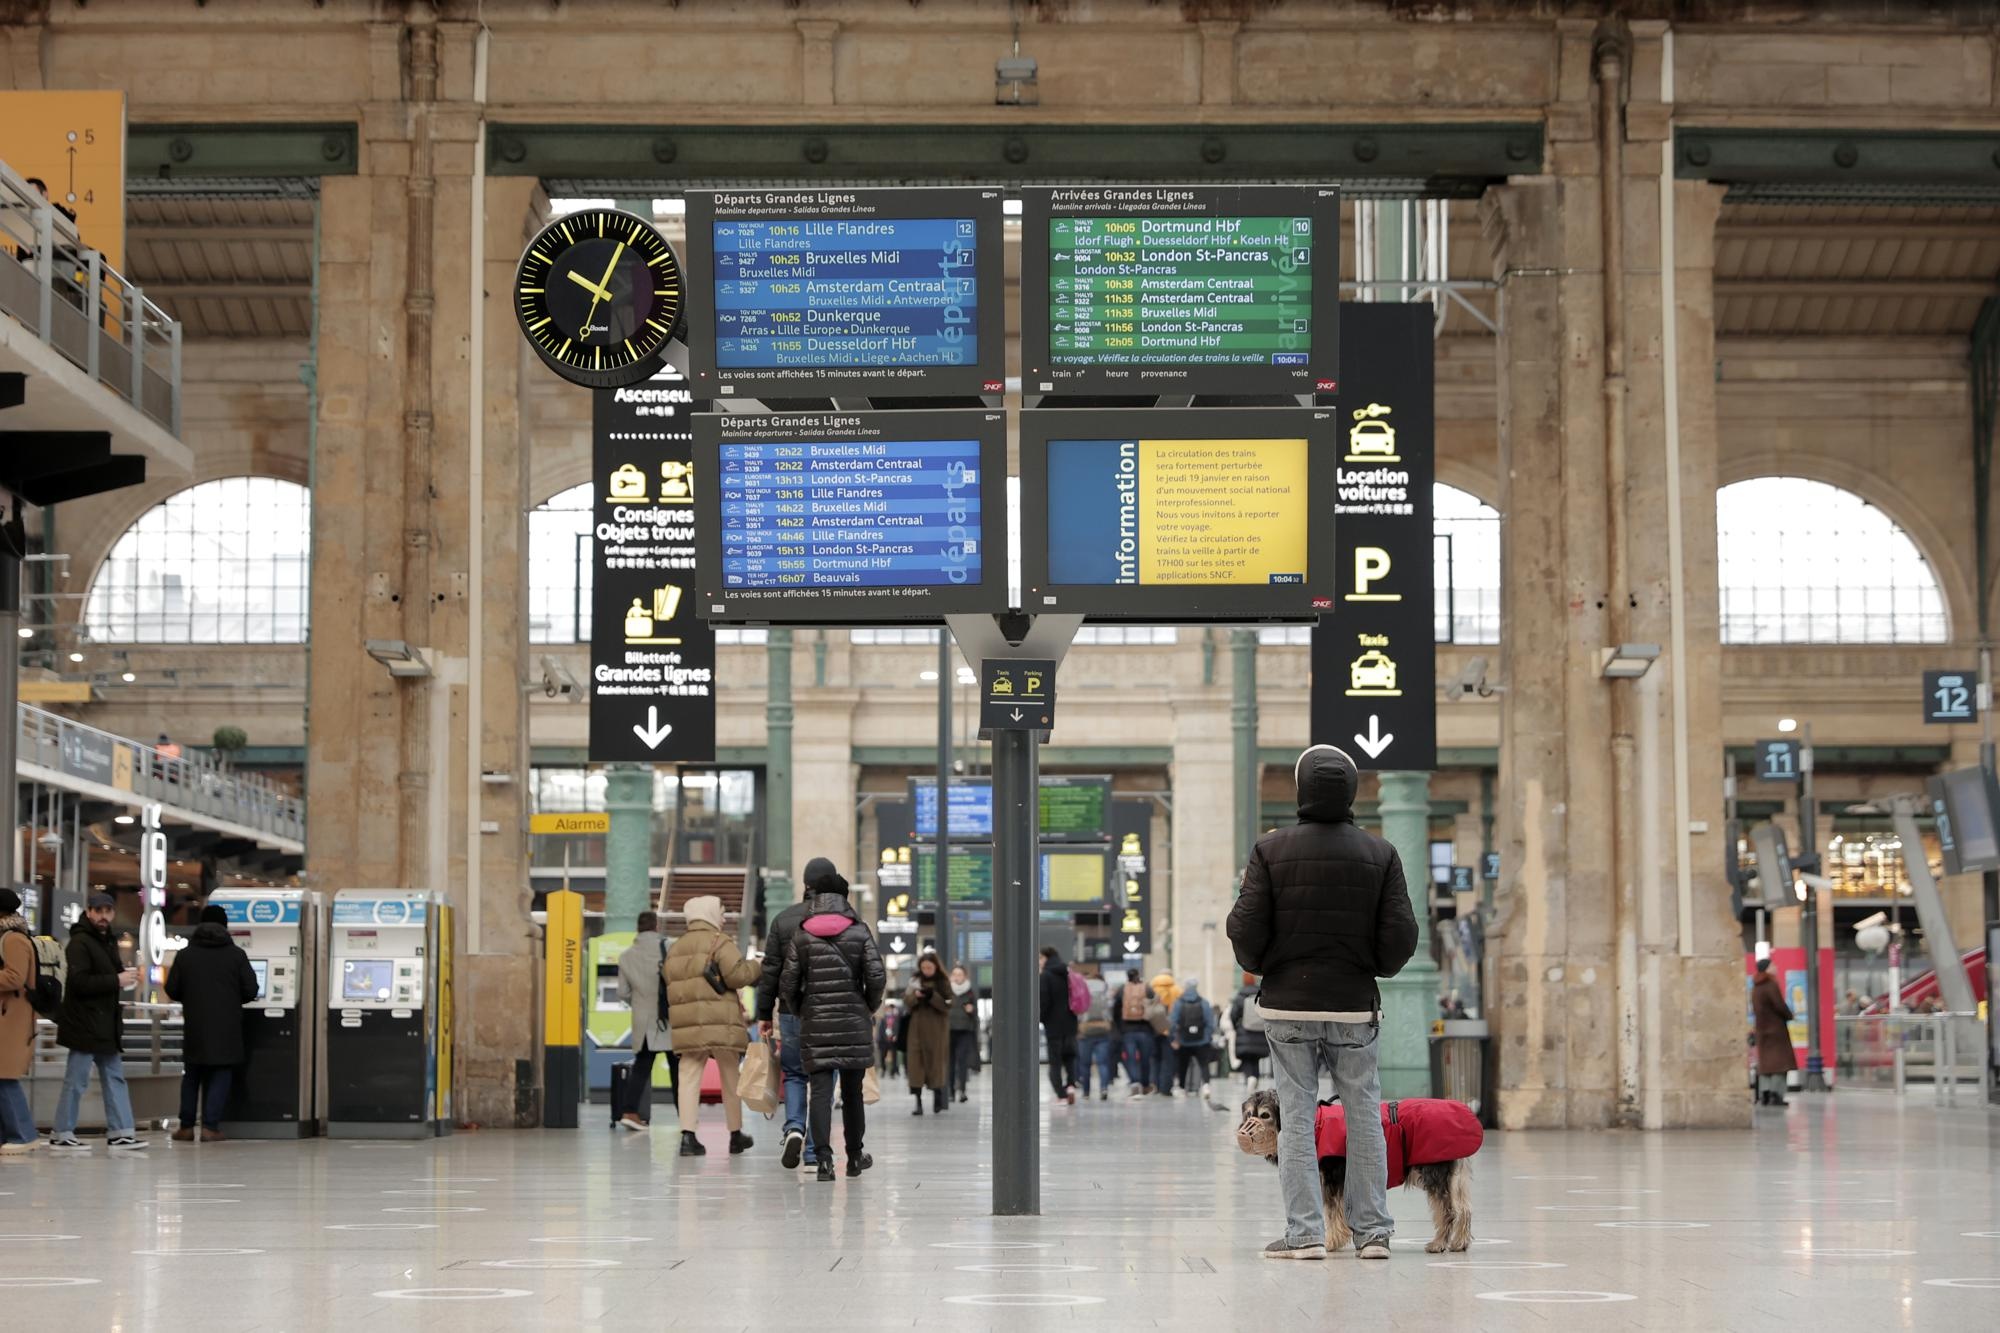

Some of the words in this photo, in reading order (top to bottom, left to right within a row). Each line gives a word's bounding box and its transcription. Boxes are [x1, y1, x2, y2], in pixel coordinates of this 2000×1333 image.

[84, 128, 95, 145] 5
[84, 189, 95, 205] 4
[714, 193, 762, 206] Départs
[765, 193, 814, 204] Grandes
[818, 193, 856, 206] Lignes
[1051, 190, 1100, 200] Arrivées
[1103, 189, 1153, 200] Grandes
[1156, 189, 1194, 202] Lignes
[715, 206, 747, 215] Mainline
[748, 206, 787, 216] departures
[793, 206, 820, 214] Salidas
[821, 205, 851, 214] Grandes
[768, 225, 800, 236] 10h16
[805, 222, 833, 236] Lille
[837, 222, 895, 236] Flandres
[959, 223, 972, 234] 12
[1105, 223, 1136, 233] 10h05
[1142, 220, 1211, 233] Dortmund
[1216, 219, 1241, 232] Hbf
[1295, 222, 1308, 232] 10
[738, 239, 761, 249] Lille
[764, 238, 811, 249] Flandres
[769, 255, 800, 265] 10h25
[806, 252, 867, 265] Bruxelles
[871, 251, 900, 264] Midi
[1105, 252, 1136, 262] 10h32
[1142, 249, 1192, 262] London
[1196, 249, 1269, 262] St-Pancras
[739, 267, 789, 278] Bruxelles
[792, 266, 816, 277] Midi
[1075, 264, 1115, 275] London
[1118, 264, 1177, 275] St-Pancras
[769, 284, 801, 294] 10h25
[806, 281, 884, 294] Amsterdam
[888, 280, 946, 293] Centraal
[1105, 280, 1133, 289] 10h38
[1141, 278, 1204, 289] Amsterdam
[1207, 278, 1254, 289] Centraal
[1104, 294, 1134, 303] 11h35
[1141, 293, 1204, 303] Amsterdam
[1207, 292, 1254, 303] Centraal
[770, 312, 801, 323] 10h52
[807, 309, 881, 324] Dunkerque
[1104, 308, 1134, 318] 11h35
[1141, 307, 1191, 318] Bruxelles
[1193, 307, 1217, 317] Midi
[1104, 323, 1134, 332] 11h56
[1141, 322, 1181, 332] London
[1185, 321, 1243, 332] St-Pancras
[771, 341, 802, 351] 11h55
[807, 338, 888, 351] Duesseldorf
[892, 337, 917, 350] Hbf
[1104, 337, 1134, 347] 12h05
[1141, 336, 1197, 347] Dortmund
[1200, 336, 1221, 346] Hbf
[718, 371, 732, 379] Les
[733, 371, 756, 379] voies
[756, 371, 775, 379] sont
[776, 370, 814, 378] affichées
[816, 370, 826, 378] 15
[827, 370, 861, 378] minutes
[887, 369, 895, 377] le
[897, 369, 927, 378] départ.
[1052, 370, 1071, 378] train
[1105, 370, 1129, 378] heure
[1141, 370, 1188, 379] provenance
[614, 387, 694, 403] Ascenseu
[720, 417, 768, 429] Départs
[771, 416, 819, 427] Grandes
[823, 416, 861, 427] Lignes
[774, 448, 803, 456] 12h22
[811, 446, 860, 456] Bruxelles
[862, 445, 886, 455] Midi
[1167, 450, 1213, 458] circulation
[1232, 449, 1256, 457] trains
[774, 462, 803, 470] 12h22
[811, 460, 873, 470] Amsterdam
[876, 459, 922, 469] Centraal
[1175, 462, 1218, 470] fortement
[1221, 462, 1263, 471] perturbée
[775, 476, 803, 484] 13h13
[811, 474, 851, 484] London
[855, 473, 913, 483] St-Pancras
[1336, 467, 1409, 484] Location
[775, 490, 804, 499] 13h16
[811, 488, 834, 498] Lille
[837, 488, 883, 498] Flandres
[1229, 486, 1253, 494] social
[1338, 485, 1408, 501] voitures
[775, 504, 804, 512] 14h22
[812, 502, 860, 513] Bruxelles
[863, 502, 887, 512] Midi
[1115, 442, 1135, 584] information
[613, 506, 694, 526] Consignes
[776, 518, 804, 527] 14h22
[811, 516, 874, 527] Amsterdam
[877, 515, 923, 525] Centraal
[596, 523, 649, 544] Objets
[812, 530, 834, 541] Lille
[838, 530, 884, 540] Flandres
[1156, 535, 1188, 543] Vérifiez
[1190, 535, 1198, 543] la
[1200, 535, 1244, 543] circulation
[776, 546, 805, 555] 15h13
[813, 545, 853, 555] London
[856, 544, 914, 554] St-Pancras
[813, 559, 869, 569] Dortmund
[872, 558, 892, 568] Hbf
[1355, 547, 1392, 594] P
[777, 574, 805, 583] 16h07
[813, 573, 860, 583] Beauvais
[1273, 576, 1293, 584] 10:04
[1358, 633, 1389, 647] Taxis
[624, 652, 681, 664] Billetterie
[594, 664, 662, 682] Grandes
[664, 665, 711, 685] lignes
[1027, 677, 1041, 693] P
[1934, 687, 1969, 713] 12
[1764, 752, 1793, 773] 11
[555, 818, 606, 831] Alarme
[565, 939, 577, 984] Alarme
